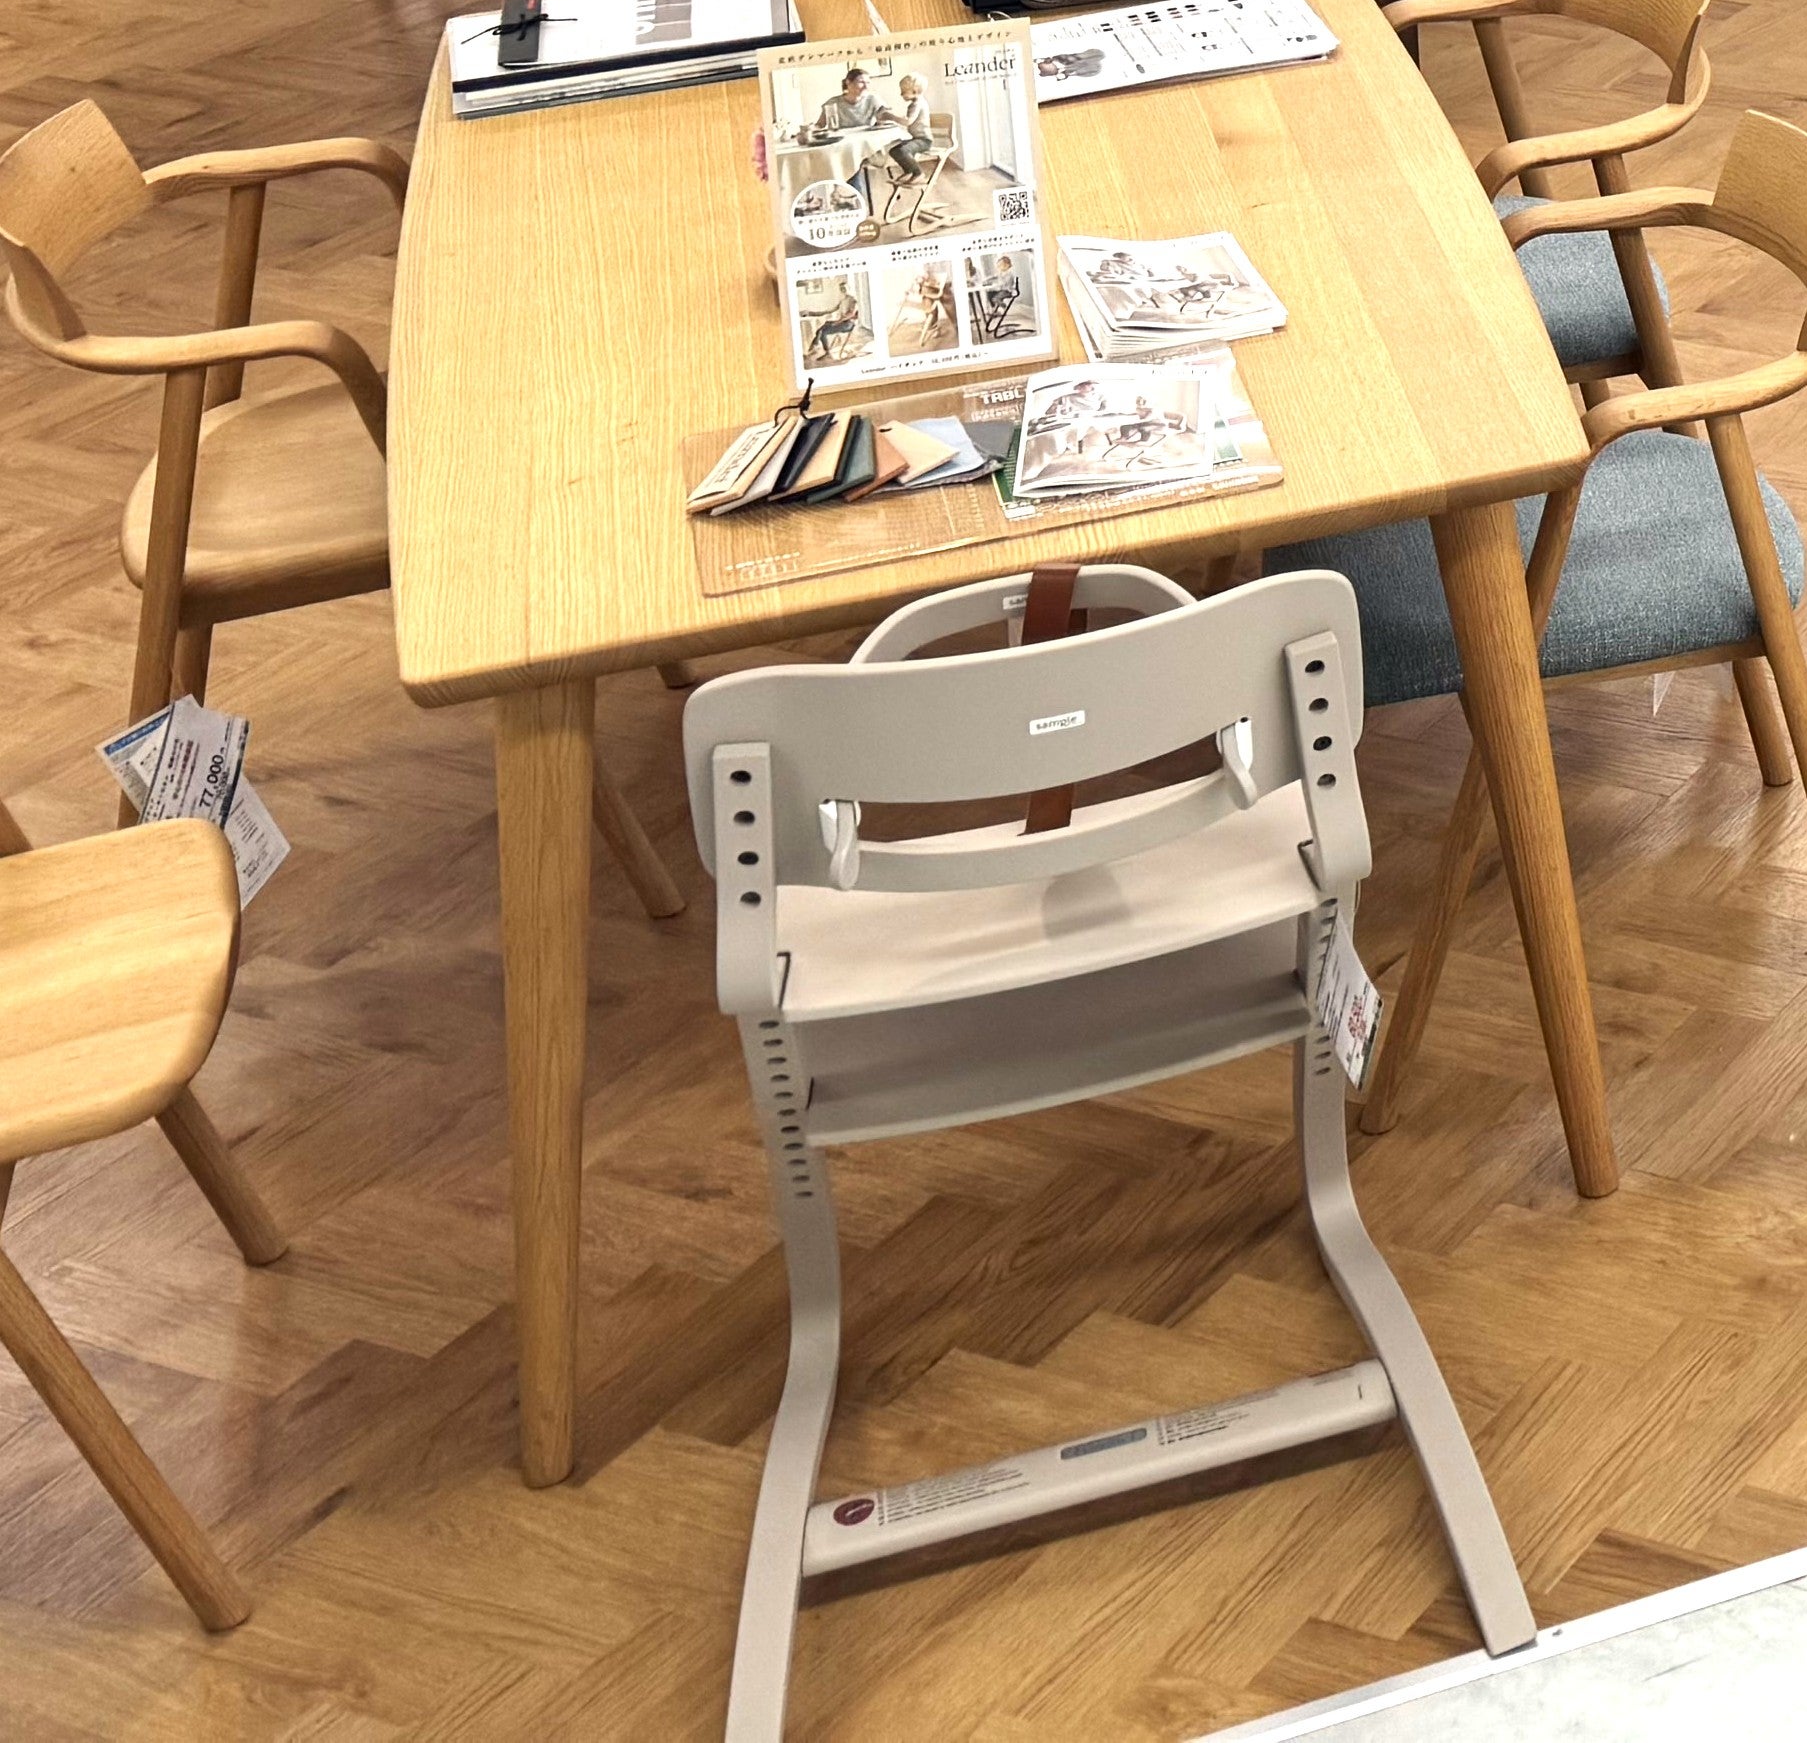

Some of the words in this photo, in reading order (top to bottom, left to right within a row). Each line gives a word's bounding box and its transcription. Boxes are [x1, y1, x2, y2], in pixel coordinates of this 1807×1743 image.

[943, 57, 1017, 78] Leander
[980, 385, 1025, 405] TABL
[199, 754, 224, 809] 77,000
